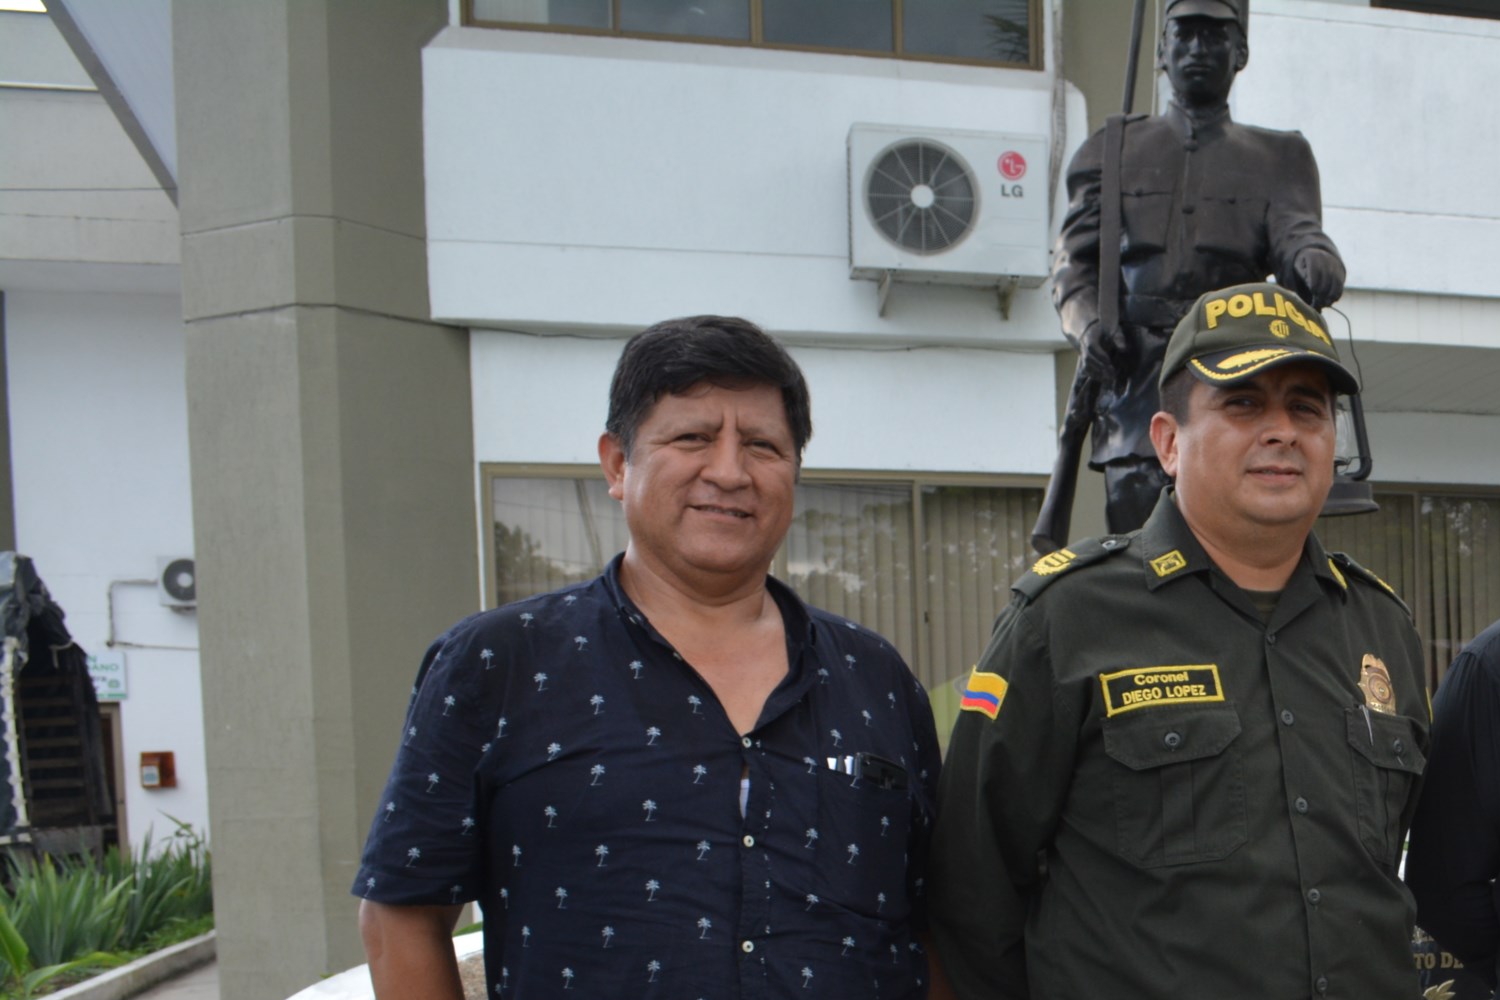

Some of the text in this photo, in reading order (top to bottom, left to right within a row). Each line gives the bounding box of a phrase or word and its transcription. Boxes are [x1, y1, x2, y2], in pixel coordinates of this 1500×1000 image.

[1000, 184, 1024, 198] LG
[1134, 671, 1190, 686] Coronel
[1122, 684, 1206, 706] DIEGO LOPEZ
